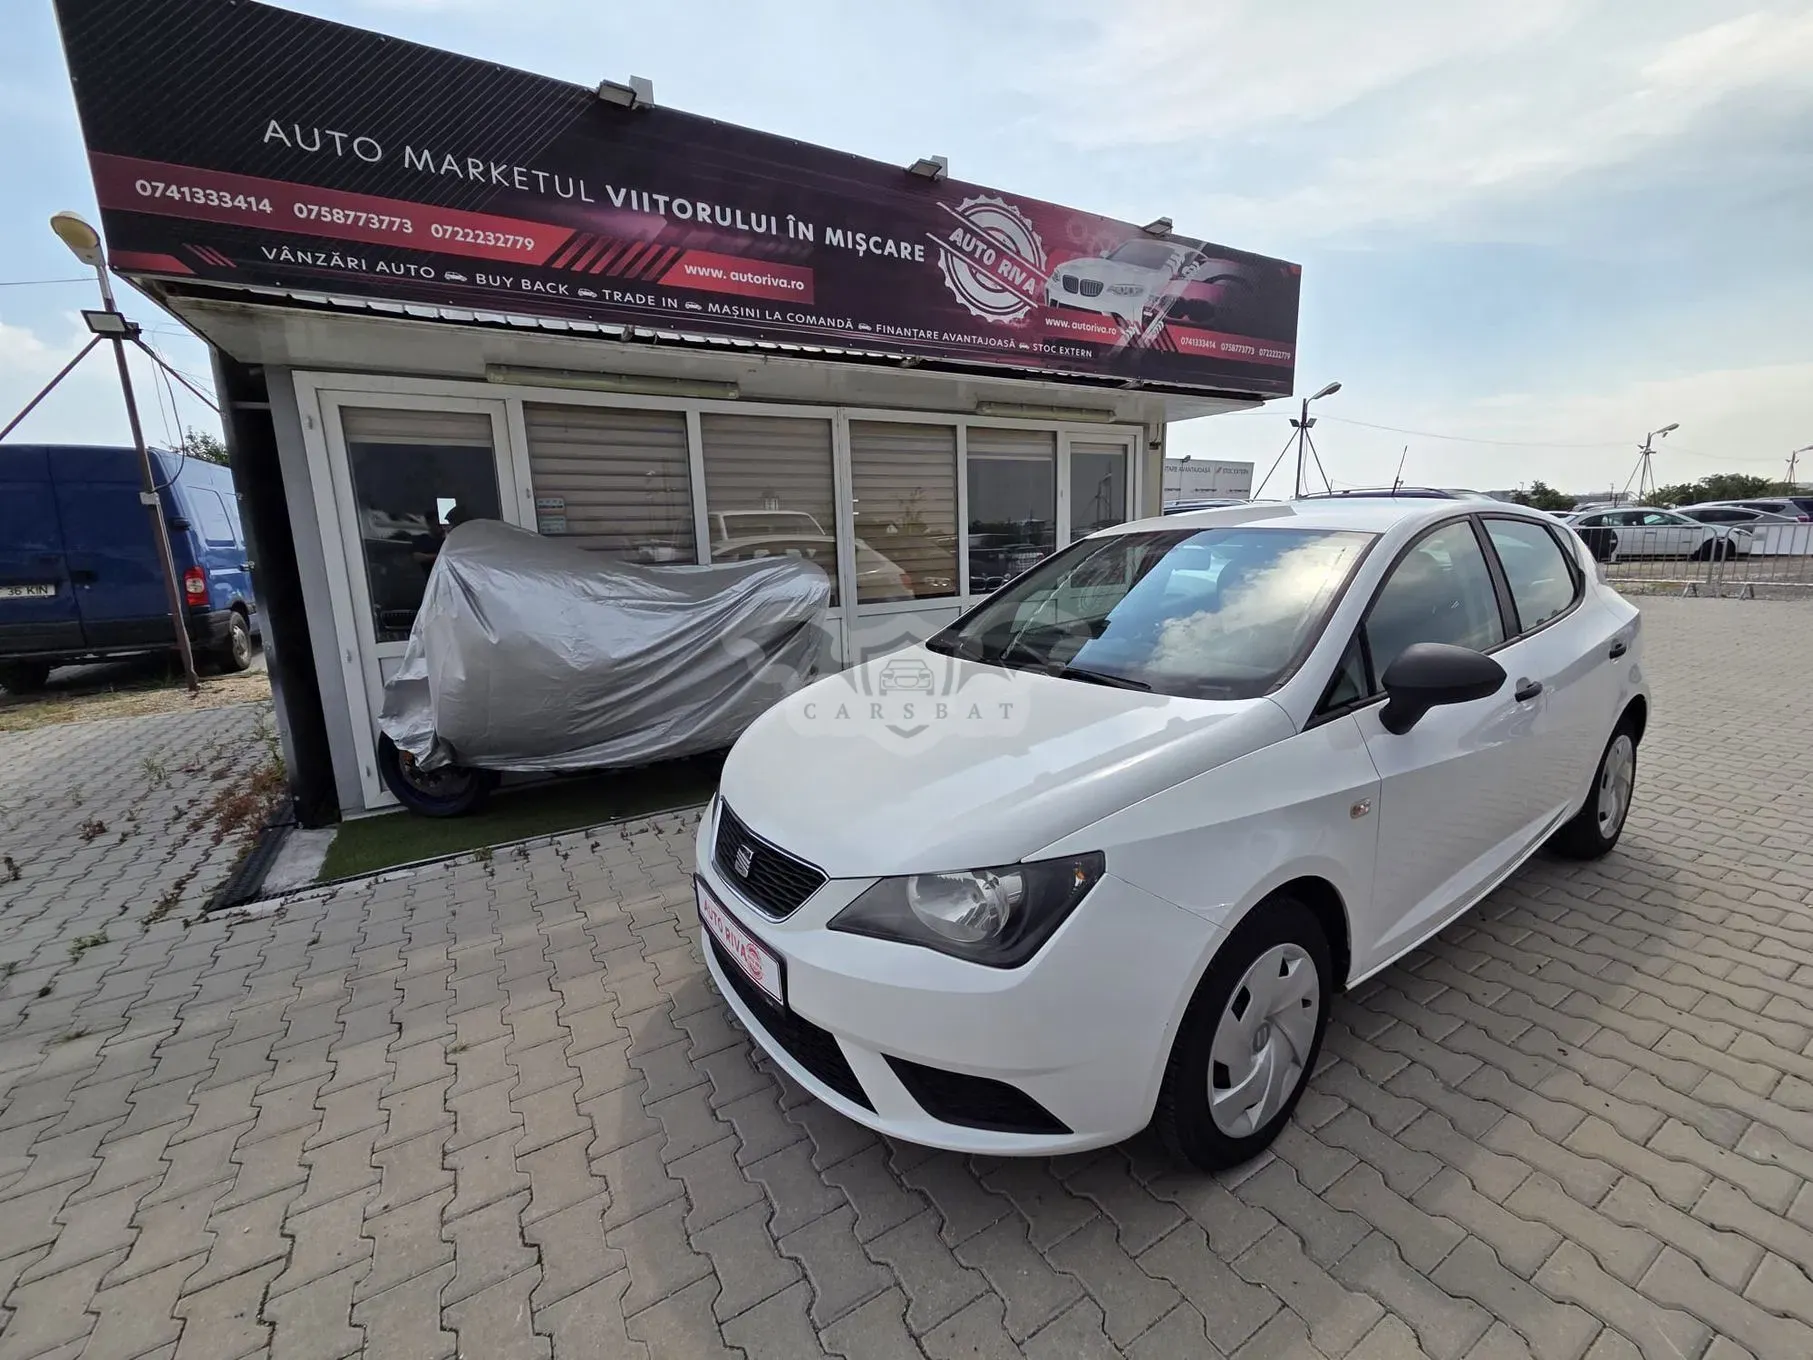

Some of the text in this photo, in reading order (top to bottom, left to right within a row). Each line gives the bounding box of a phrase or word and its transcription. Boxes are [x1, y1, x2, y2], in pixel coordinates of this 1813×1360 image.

[135, 179, 535, 252] 0741333414 0758773773 0722232779
[263, 118, 925, 262] AUTO MARKETUL VIITORULUI ÎN MIȘCARE
[684, 264, 805, 291] www. autoriva.ro
[947, 227, 1035, 295] AUTO RIVA
[261, 244, 367, 271] VÂNZĂRI
[376, 262, 435, 279] AUTO
[476, 273, 514, 288] BUY
[521, 279, 569, 297] BACK
[602, 290, 655, 307] TRADE
[662, 297, 678, 309] IN
[708, 302, 760, 320] MAȘINI
[766, 310, 783, 321] LA
[787, 312, 854, 330] COMANDĂ
[942, 333, 1016, 349] AVANTAJOASĂ
[1032, 343, 1057, 355] STOC
[1058, 345, 1093, 359] EXTERN
[1045, 316, 1117, 336] www. autoriva.ro
[1180, 336, 1291, 361] 0741333414 0758773773 0722232779
[27, 585, 48, 595] KIN
[704, 900, 748, 962] AUTO RIVA
